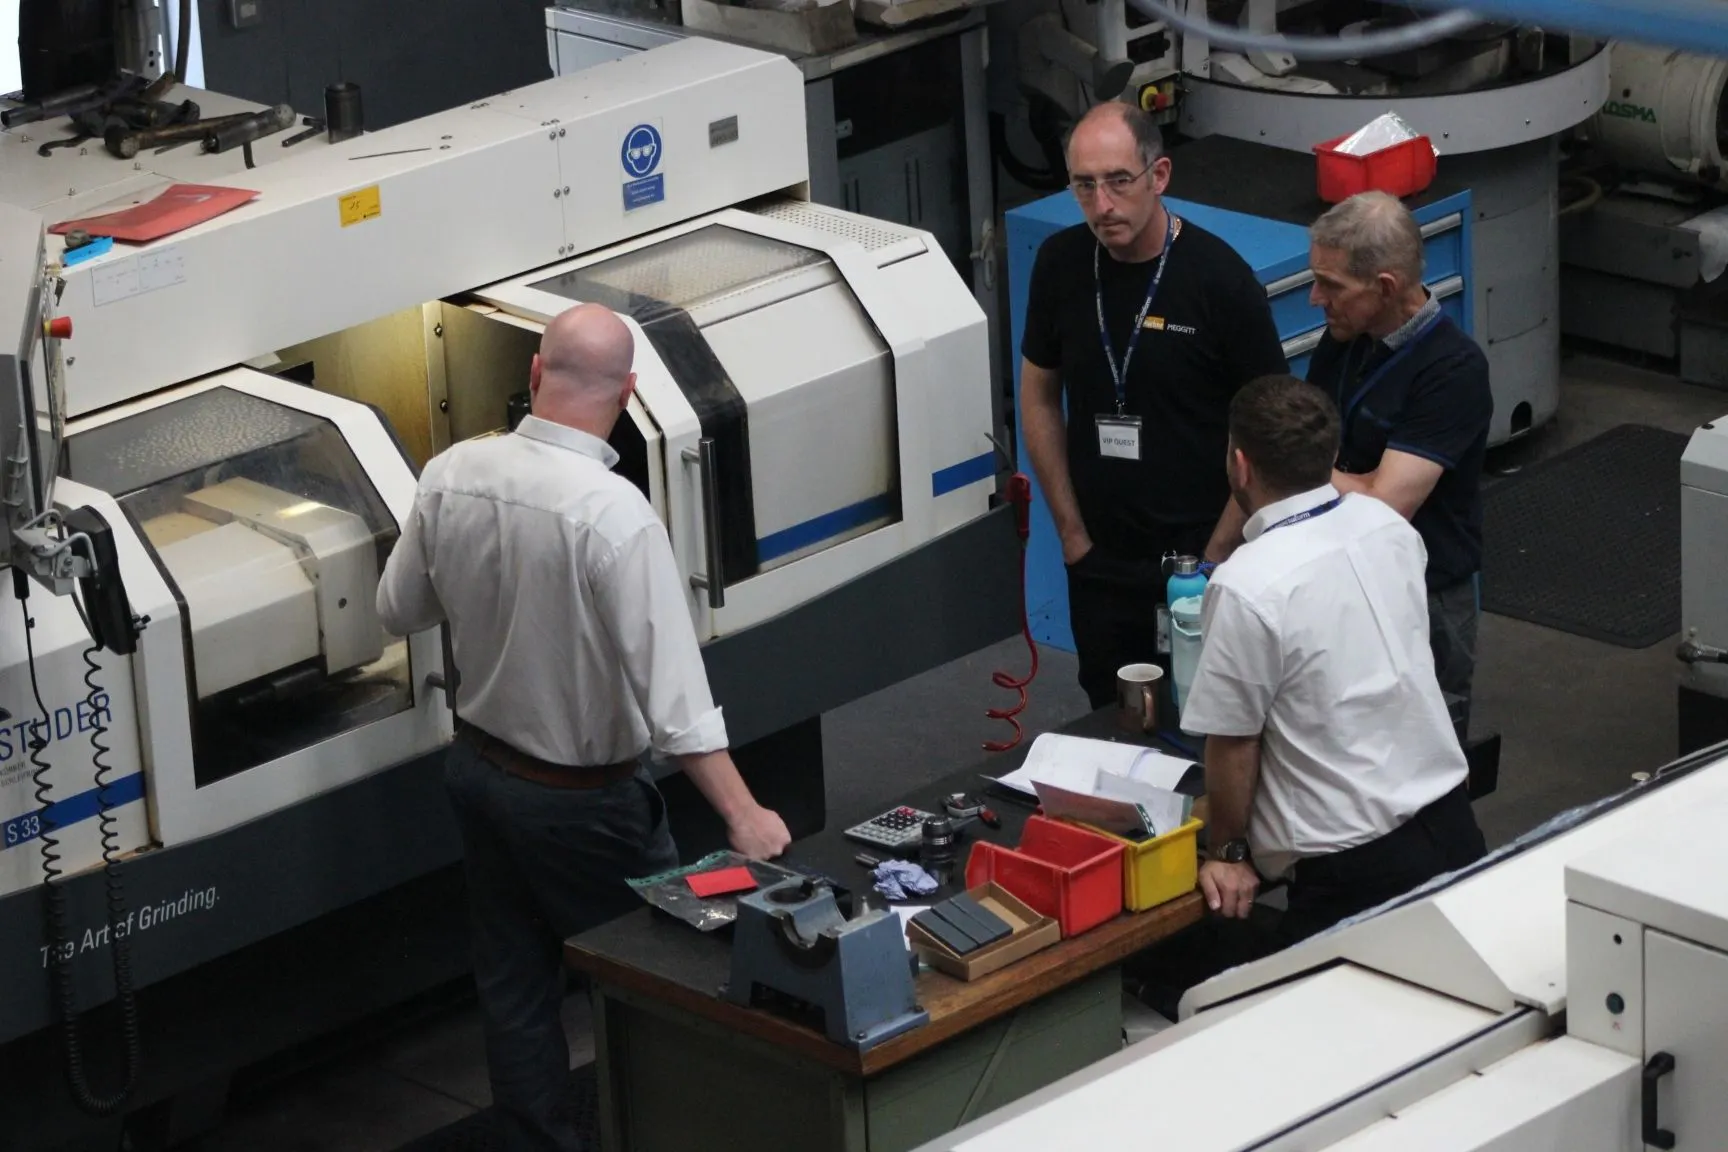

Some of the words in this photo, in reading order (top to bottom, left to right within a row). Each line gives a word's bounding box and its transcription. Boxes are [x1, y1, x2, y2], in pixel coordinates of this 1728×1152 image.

[1166, 323, 1196, 335] MEGGITT
[1102, 437, 1113, 445] VIP
[0, 692, 113, 761] STUDER
[7, 823, 18, 843] S
[21, 815, 41, 838] 33
[40, 940, 75, 969] Te
[79, 924, 111, 953] Art
[115, 911, 135, 939] of
[138, 885, 221, 931] Grinding.
